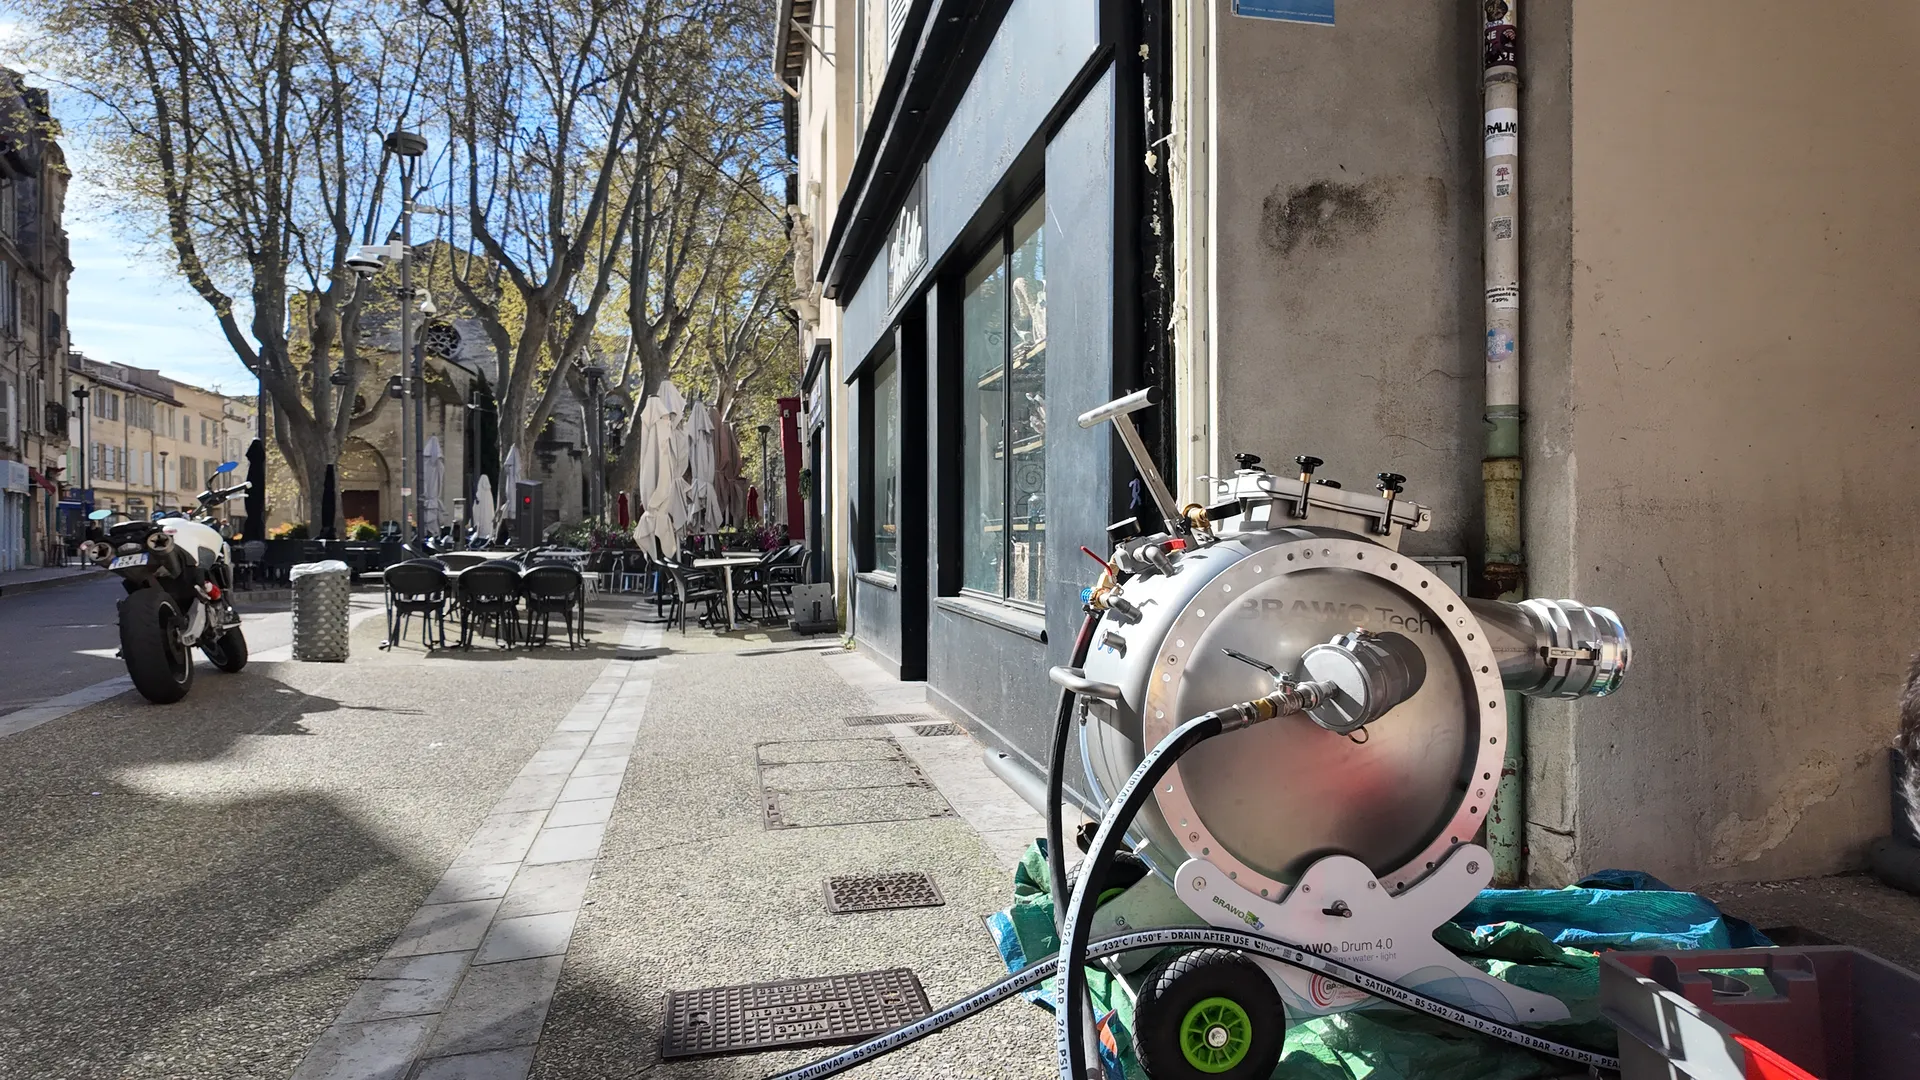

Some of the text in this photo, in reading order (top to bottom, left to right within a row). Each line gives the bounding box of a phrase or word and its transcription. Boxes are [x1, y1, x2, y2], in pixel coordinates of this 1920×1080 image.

[1376, 607, 1434, 635] Tech
[1102, 937, 1129, 952] 232°C
[1136, 932, 1161, 944] 450°F
[1171, 930, 1201, 941] DRAIN
[1203, 932, 1231, 945] AFTER
[1232, 936, 1250, 947] USE
[1342, 940, 1372, 953] Drum
[1375, 938, 1393, 951] 4.0
[1352, 954, 1374, 963] water
[1380, 951, 1396, 962] light
[1057, 978, 1065, 1005] BAR
[797, 1057, 844, 1080] SATURVAP
[853, 1047, 865, 1060] BS
[866, 1039, 889, 1056] 5342
[895, 1031, 908, 1044] 2A
[915, 1023, 925, 1036] 19
[933, 1012, 955, 1027] 2024
[961, 1001, 972, 1013] 18
[972, 993, 990, 1010] BAR
[997, 983, 1013, 998] 261
[1014, 975, 1029, 988] PSI
[1057, 1020, 1065, 1044] 261
[1364, 978, 1408, 1001] SATURVAP
[1415, 998, 1426, 1009] BS
[1427, 1001, 1447, 1017] 5342
[1454, 1011, 1465, 1023] 2A
[1474, 1019, 1484, 1030] 19
[1492, 1025, 1513, 1039] 2024
[1520, 1034, 1531, 1045] 18
[1532, 1038, 1550, 1051] BAR
[1558, 1046, 1575, 1057] 261
[1577, 1049, 1592, 1062] PSI
[1601, 1057, 1620, 1068] PEA
[1060, 1050, 1068, 1070] PSI
